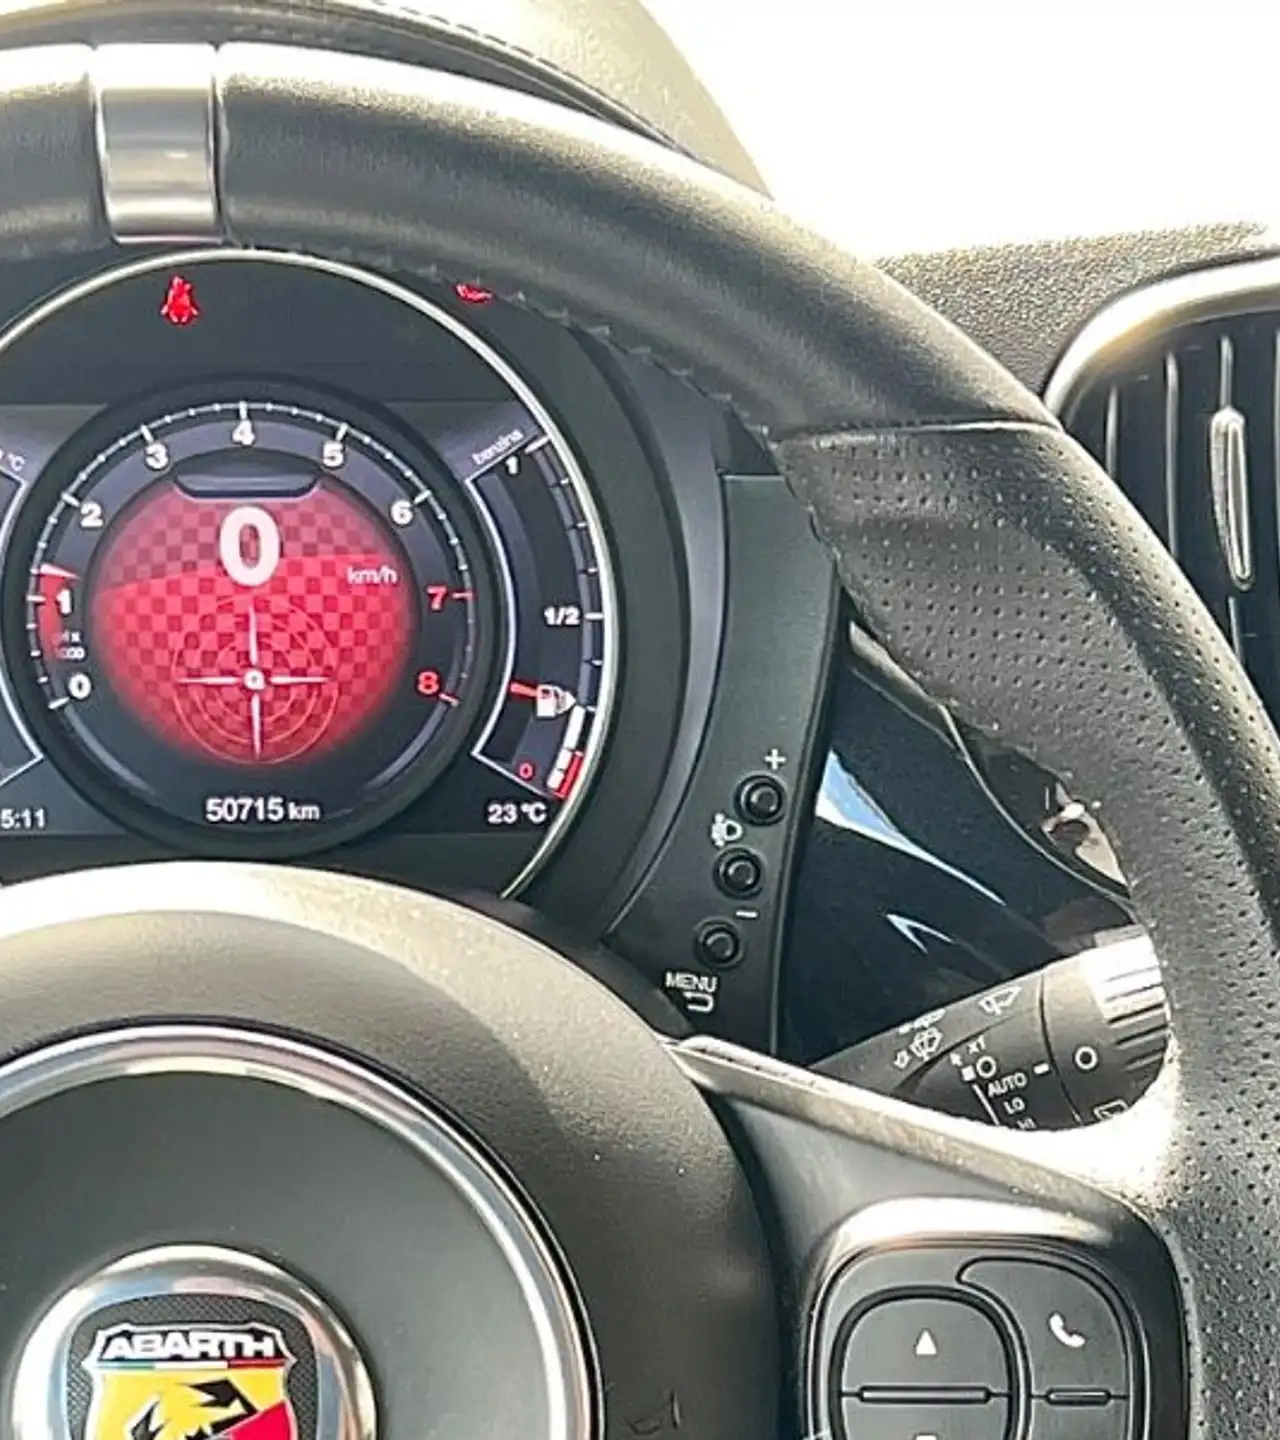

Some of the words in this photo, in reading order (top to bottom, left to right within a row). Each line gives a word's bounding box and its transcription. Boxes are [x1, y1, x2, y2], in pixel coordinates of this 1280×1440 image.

[232, 419, 254, 447] 4
[147, 443, 170, 470] 3
[323, 443, 344, 468] 5
[506, 456, 519, 475] 1
[80, 501, 104, 528] 2
[391, 500, 415, 526] 6
[218, 504, 280, 587] 0
[347, 561, 399, 587] km/h
[55, 588, 72, 615] 1
[427, 587, 446, 611] 7
[543, 606, 581, 627] 1/2
[68, 673, 92, 700] 0
[417, 671, 440, 696] 8
[519, 763, 534, 780] 0
[206, 798, 286, 822] 50715
[288, 801, 321, 821] km
[488, 804, 517, 824] 23
[521, 803, 547, 823] °C
[665, 972, 717, 993] MENU
[987, 1071, 1028, 1097] AUTO
[1003, 1096, 1026, 1115] LO
[103, 1331, 274, 1359] ABARTH
